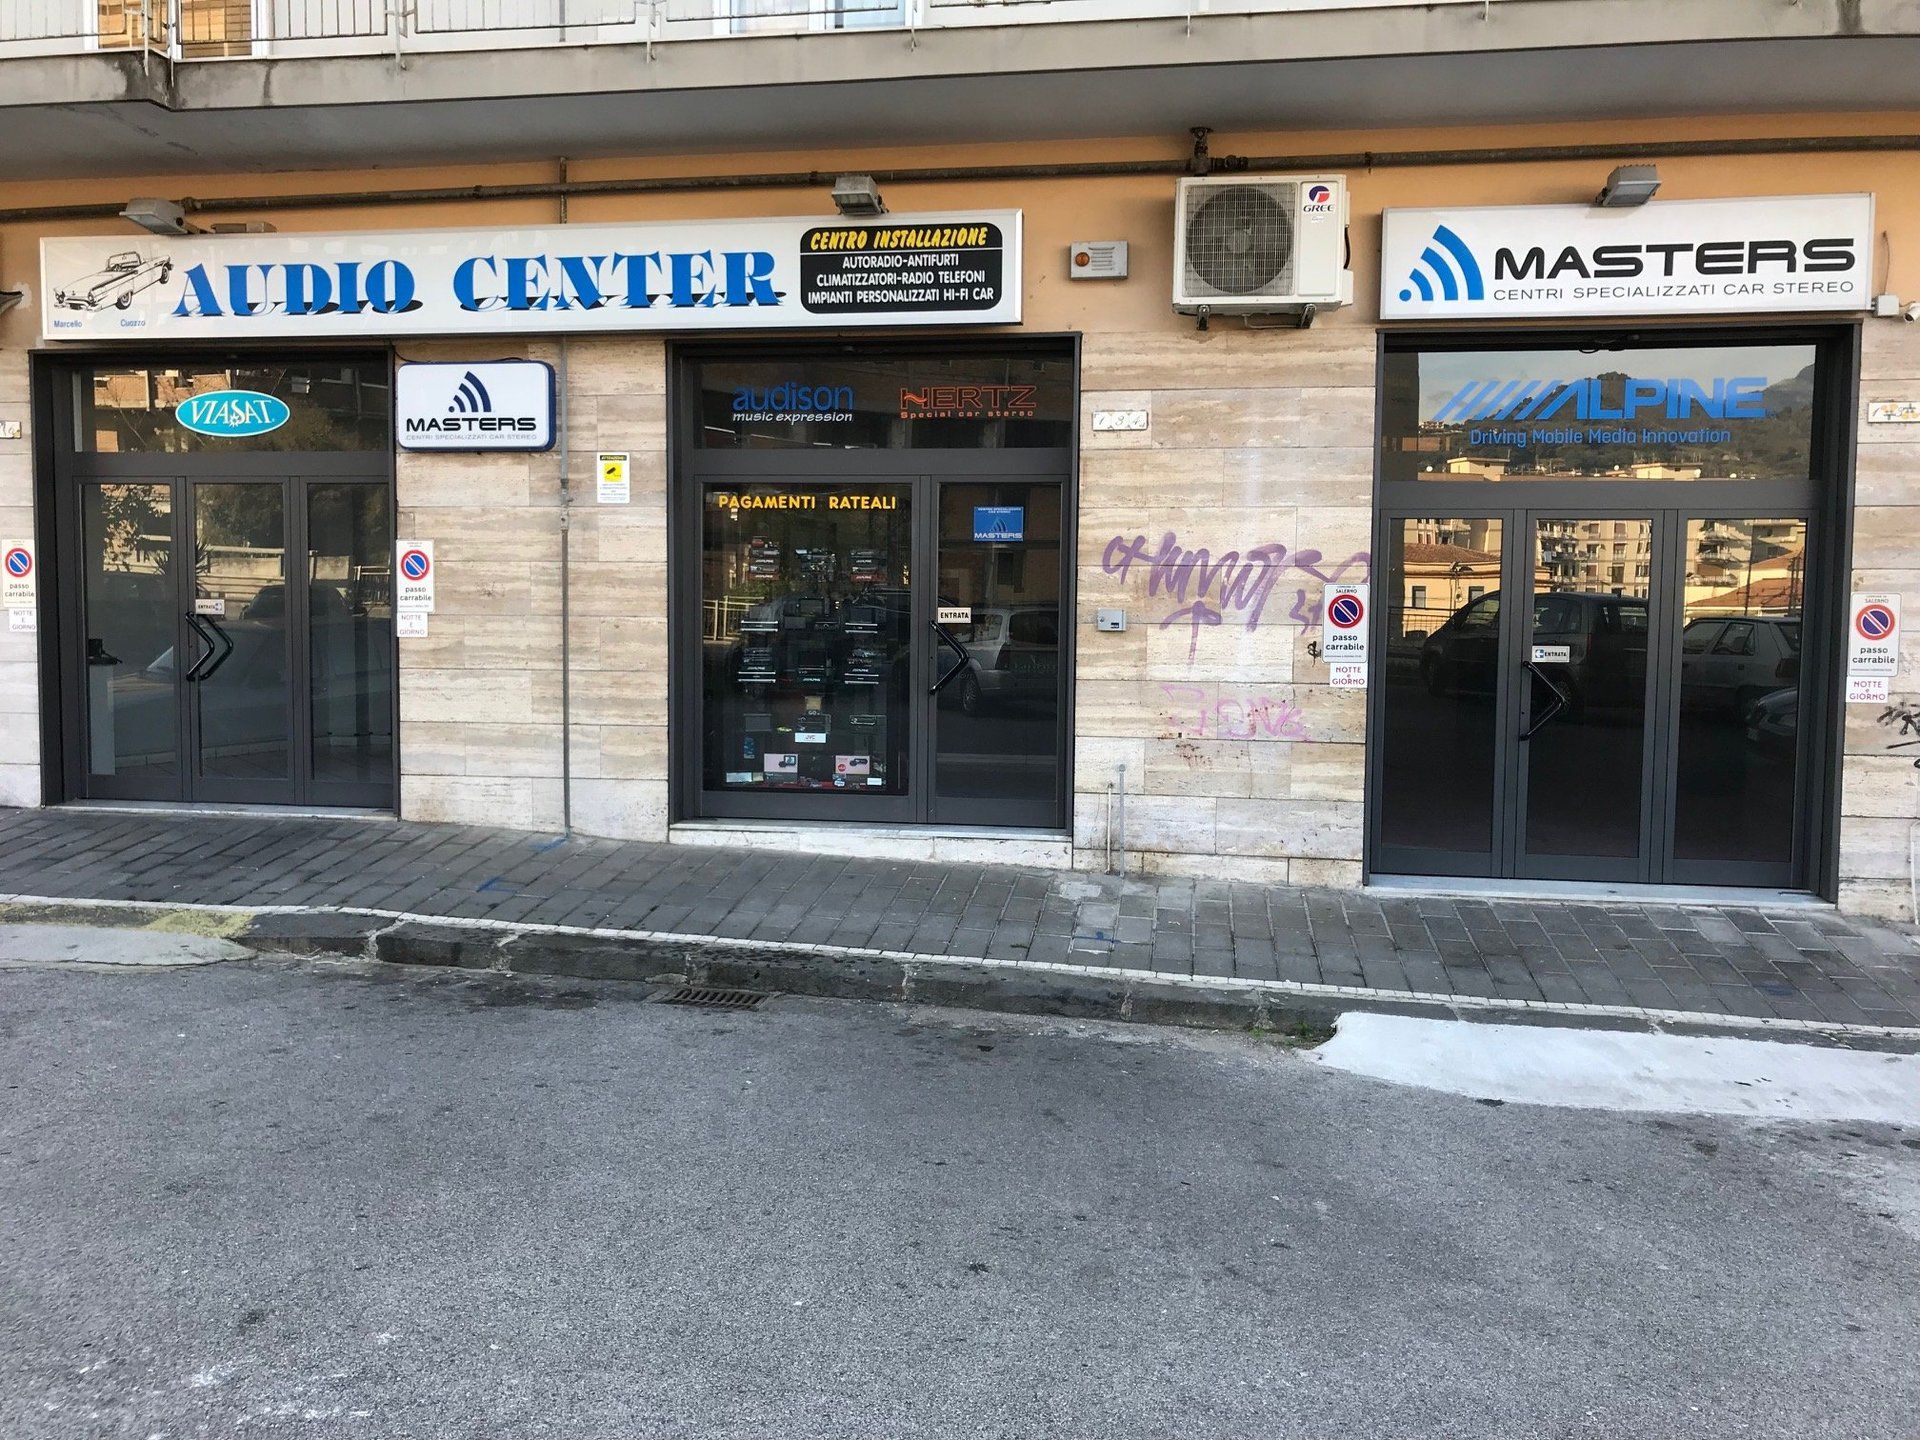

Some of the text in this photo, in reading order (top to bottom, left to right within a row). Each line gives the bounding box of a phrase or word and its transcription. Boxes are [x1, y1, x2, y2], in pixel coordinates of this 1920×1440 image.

[1303, 204, 1334, 212] GREE
[810, 227, 989, 250] CENTRO INSTALLAZIONE
[842, 253, 959, 269] AUTORADIO-ANTIFURTI
[1494, 237, 1856, 281] MASTERS
[171, 250, 785, 316] AUDIO CENTER
[816, 270, 986, 287] CLIMATIZZATORI-RADIO TELEFONI
[808, 287, 994, 304] IMPIANTI PERSONALIZZATI HI-FI CAR
[1494, 281, 1854, 301] CENTRI SPECIALIZZATI CAR STEREO
[53, 320, 82, 328] Marcello
[732, 381, 853, 411] audison
[900, 385, 1036, 409] HERTZ
[1534, 377, 1767, 420] ALPINE
[191, 399, 272, 425] VIASAT
[733, 411, 853, 425] music expression
[900, 410, 951, 419] Special
[406, 417, 536, 432] MASTERS
[1470, 427, 1731, 447] Driving Mobile Media Innovation
[718, 495, 896, 510] PAGAMENTI RATEALI
[5, 589, 34, 597] carrabile
[1332, 634, 1357, 642] passo
[1325, 643, 1365, 651] carrabile
[1852, 656, 1895, 664] carrabile
